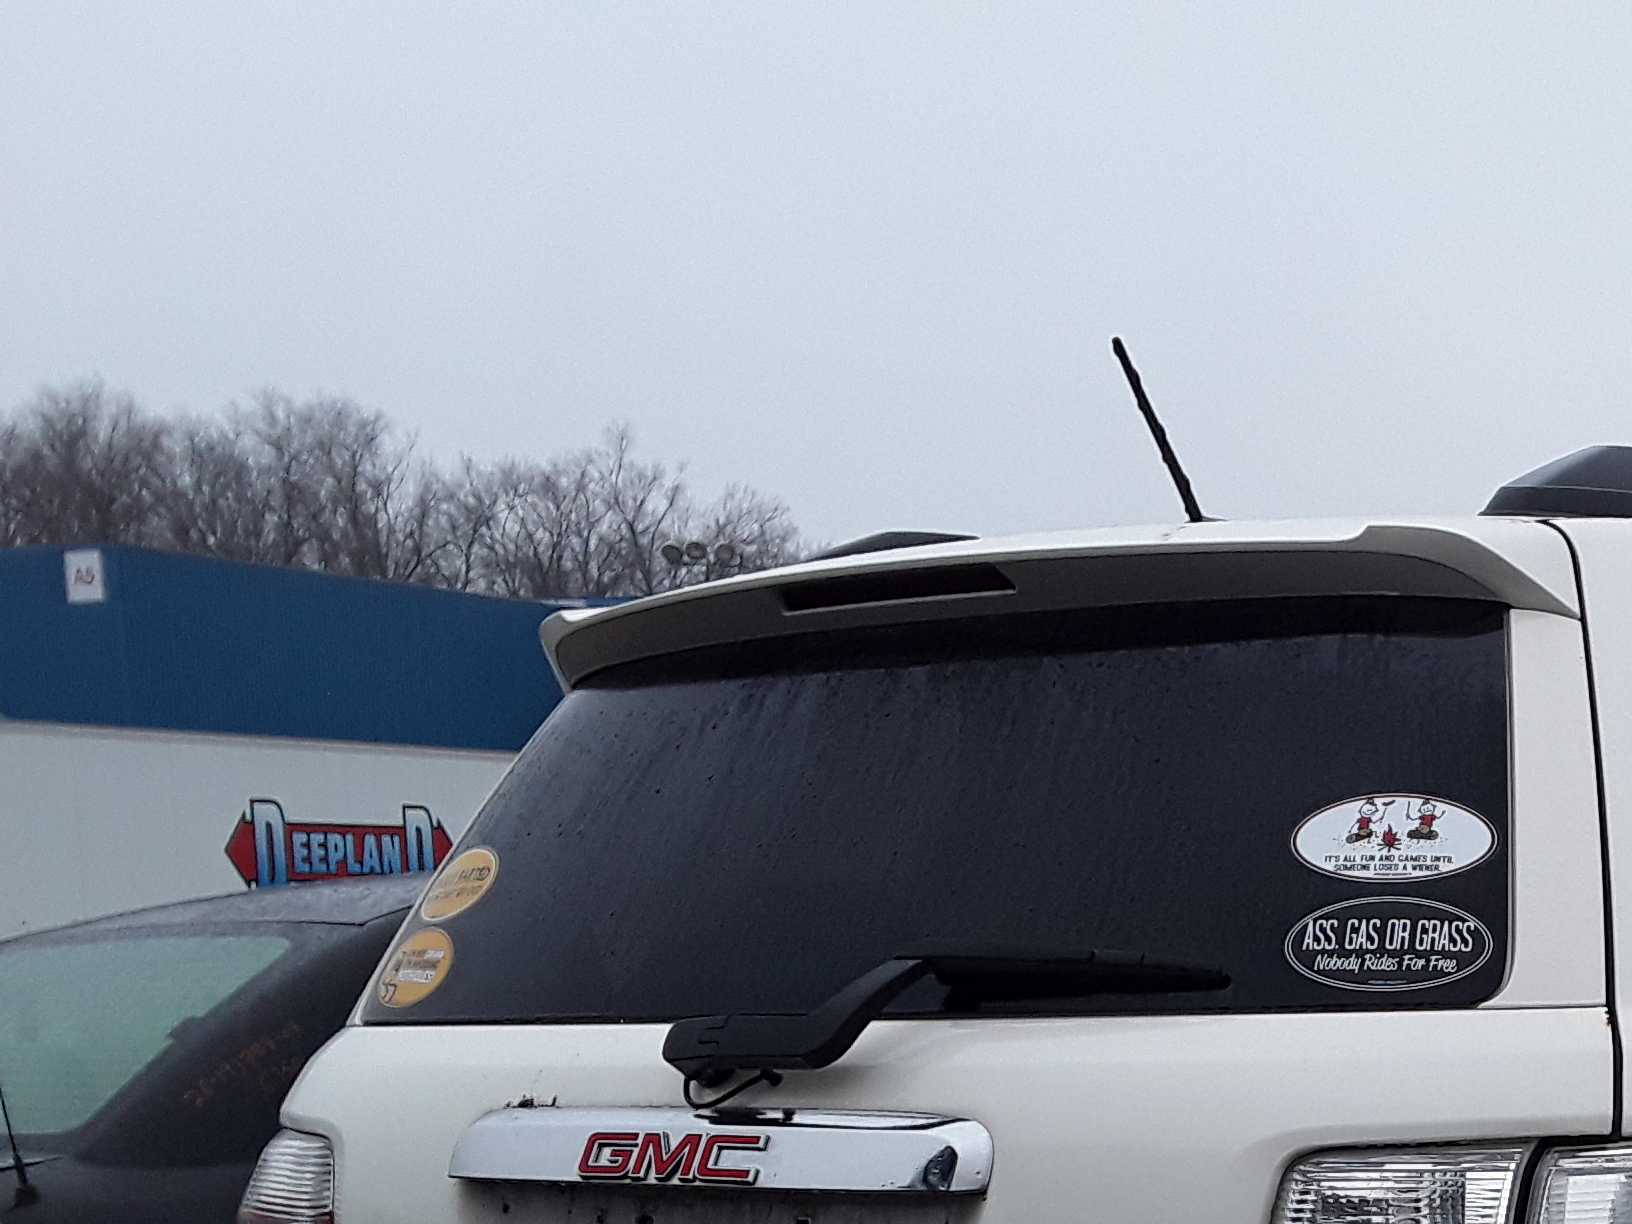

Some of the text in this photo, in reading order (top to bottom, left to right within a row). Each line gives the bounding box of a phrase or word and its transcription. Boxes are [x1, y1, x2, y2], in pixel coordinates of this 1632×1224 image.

[1334, 863, 1371, 871] SOMEONE
[1373, 863, 1399, 871] LOSES
[1402, 863, 1408, 871] A
[1343, 854, 1356, 862] ALL
[1360, 854, 1376, 862] FUN
[1378, 854, 1395, 862] AND
[1398, 854, 1428, 862] GAMES
[1344, 918, 1381, 950] GAS
[1385, 918, 1411, 950] OR
[1415, 919, 1475, 952] GRASS
[1313, 953, 1458, 974] Nobody Rides For Free
[578, 1130, 771, 1186] GMC
